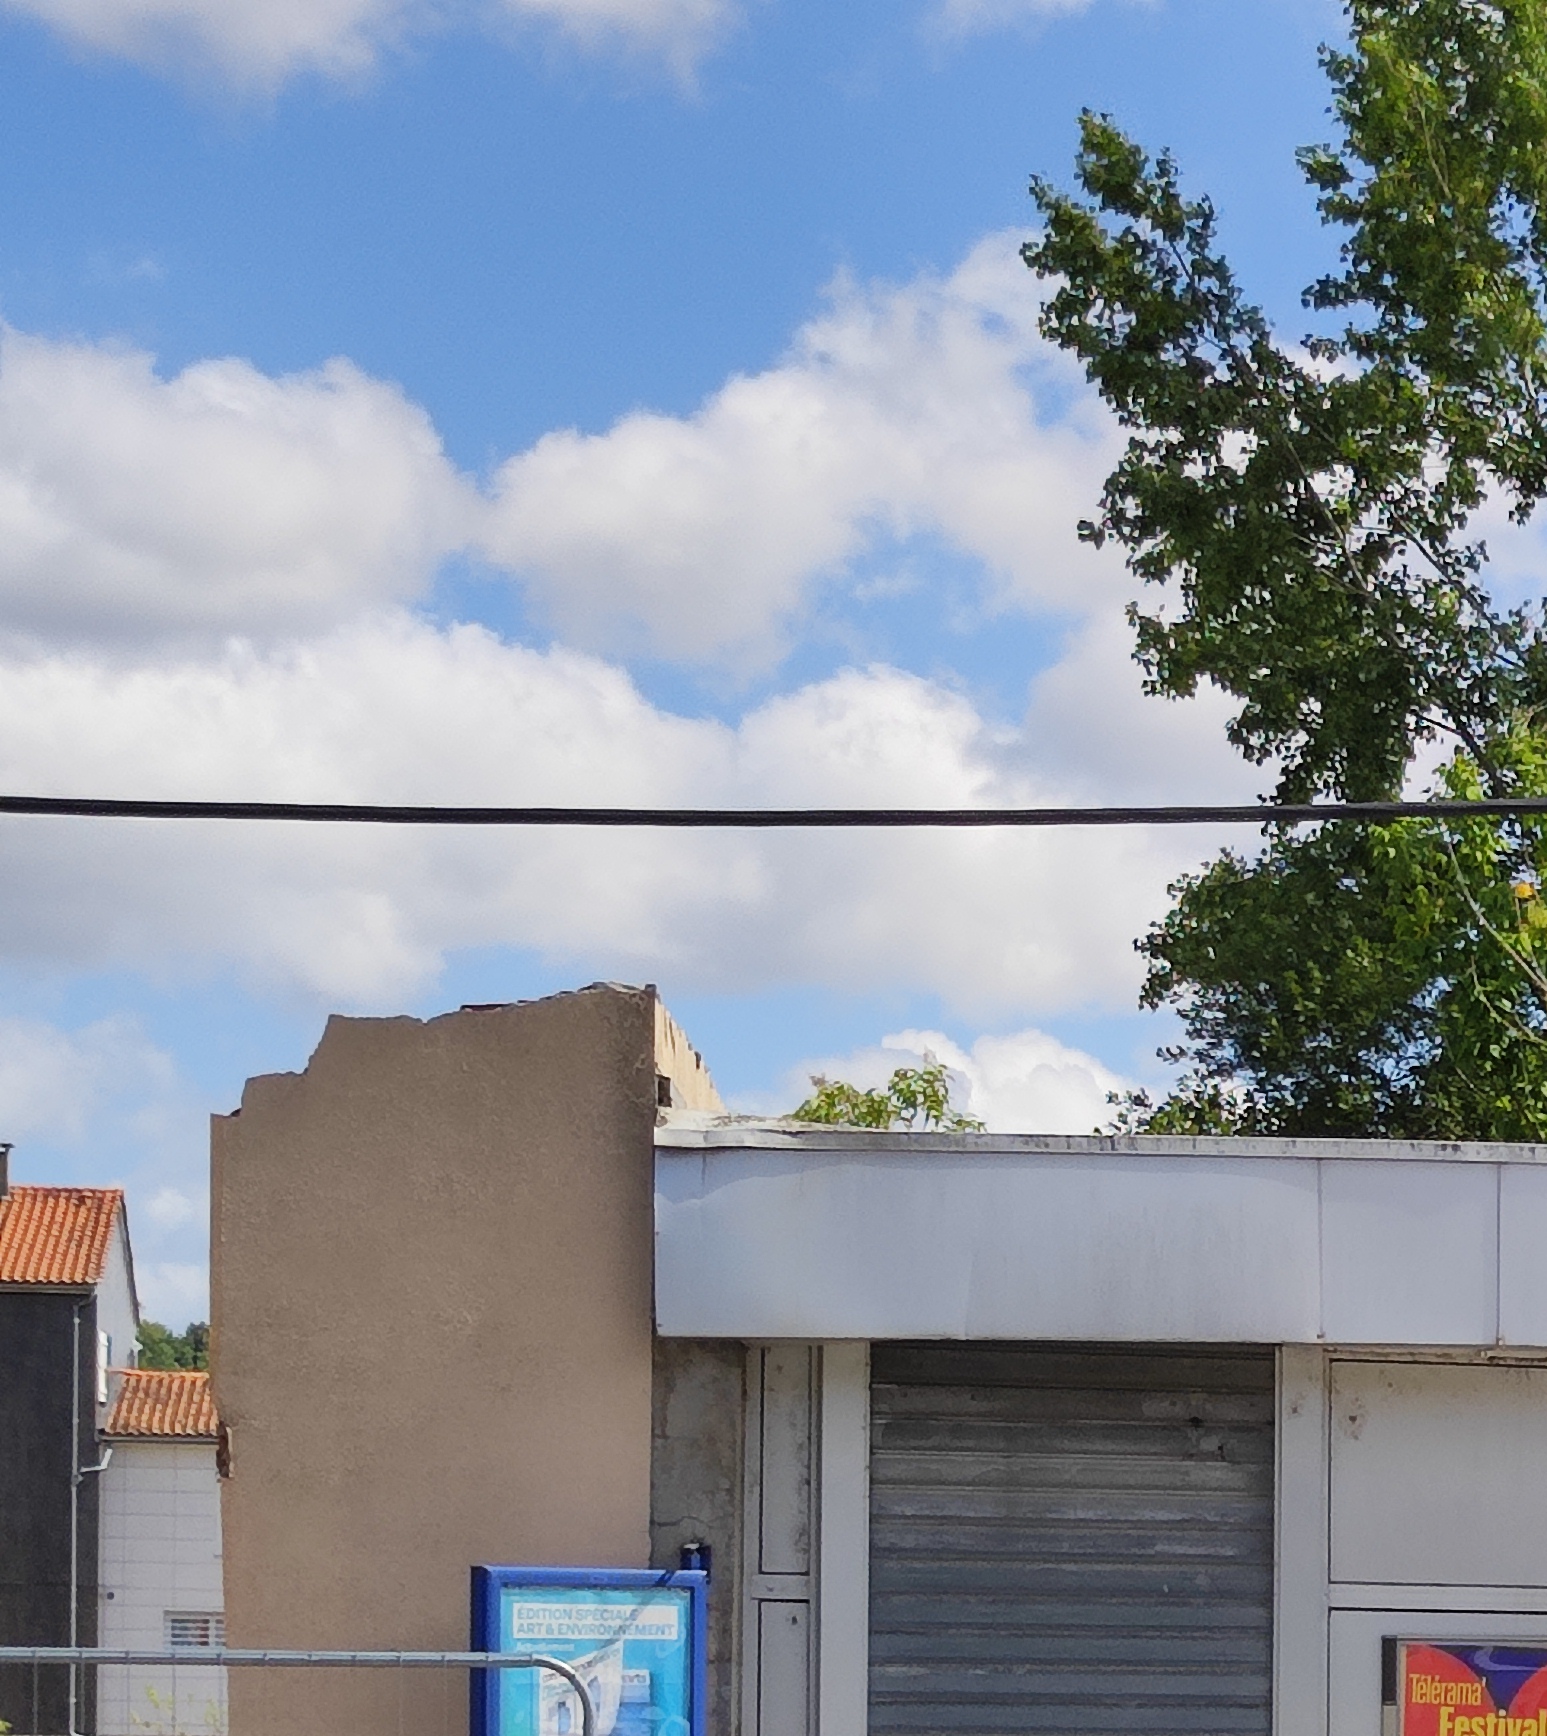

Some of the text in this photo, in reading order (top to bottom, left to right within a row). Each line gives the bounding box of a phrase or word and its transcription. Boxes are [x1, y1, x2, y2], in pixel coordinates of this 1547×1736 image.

[516, 1606, 639, 1622] ÉDITION SPÉCIALE
[516, 1623, 675, 1637] ART & ENVIRONNEMENT
